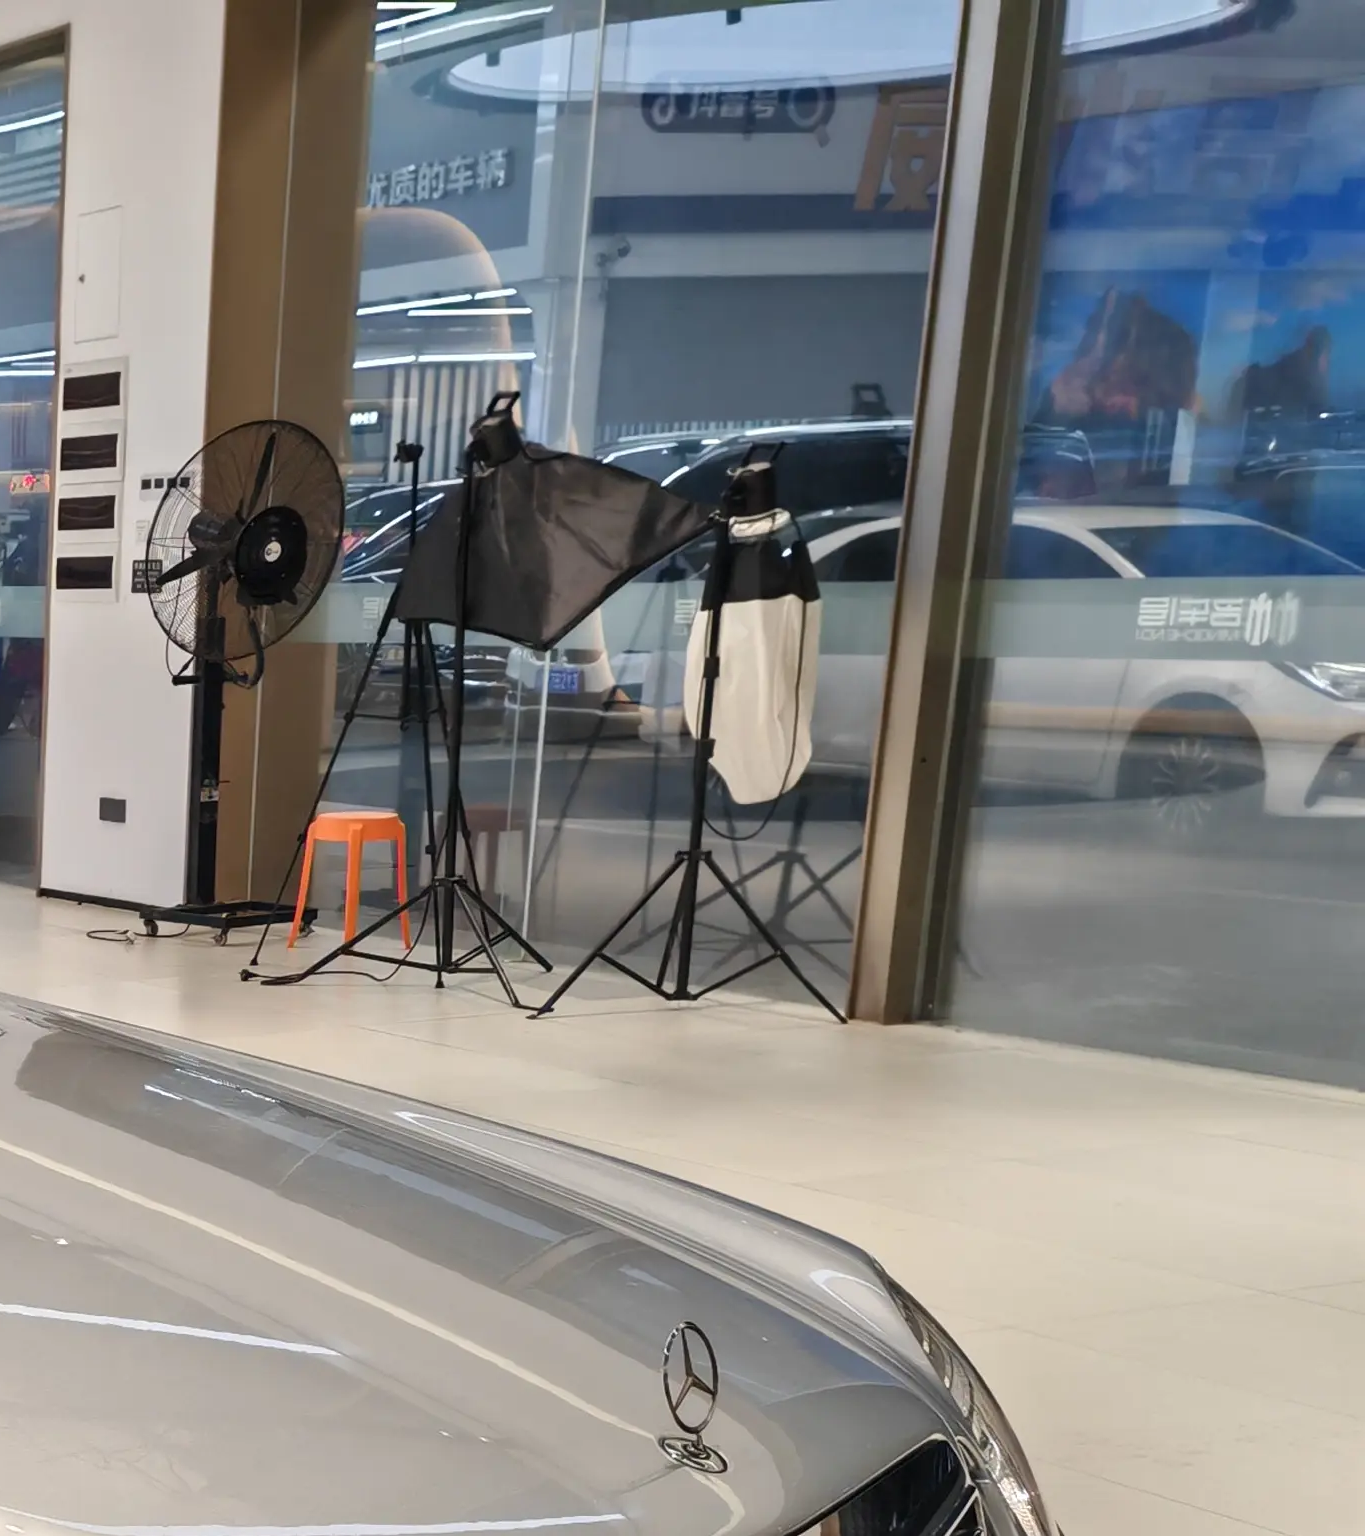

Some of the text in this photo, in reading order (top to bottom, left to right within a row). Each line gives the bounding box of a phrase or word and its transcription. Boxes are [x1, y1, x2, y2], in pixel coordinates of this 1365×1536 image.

[367, 148, 508, 210] 优质的车辆
